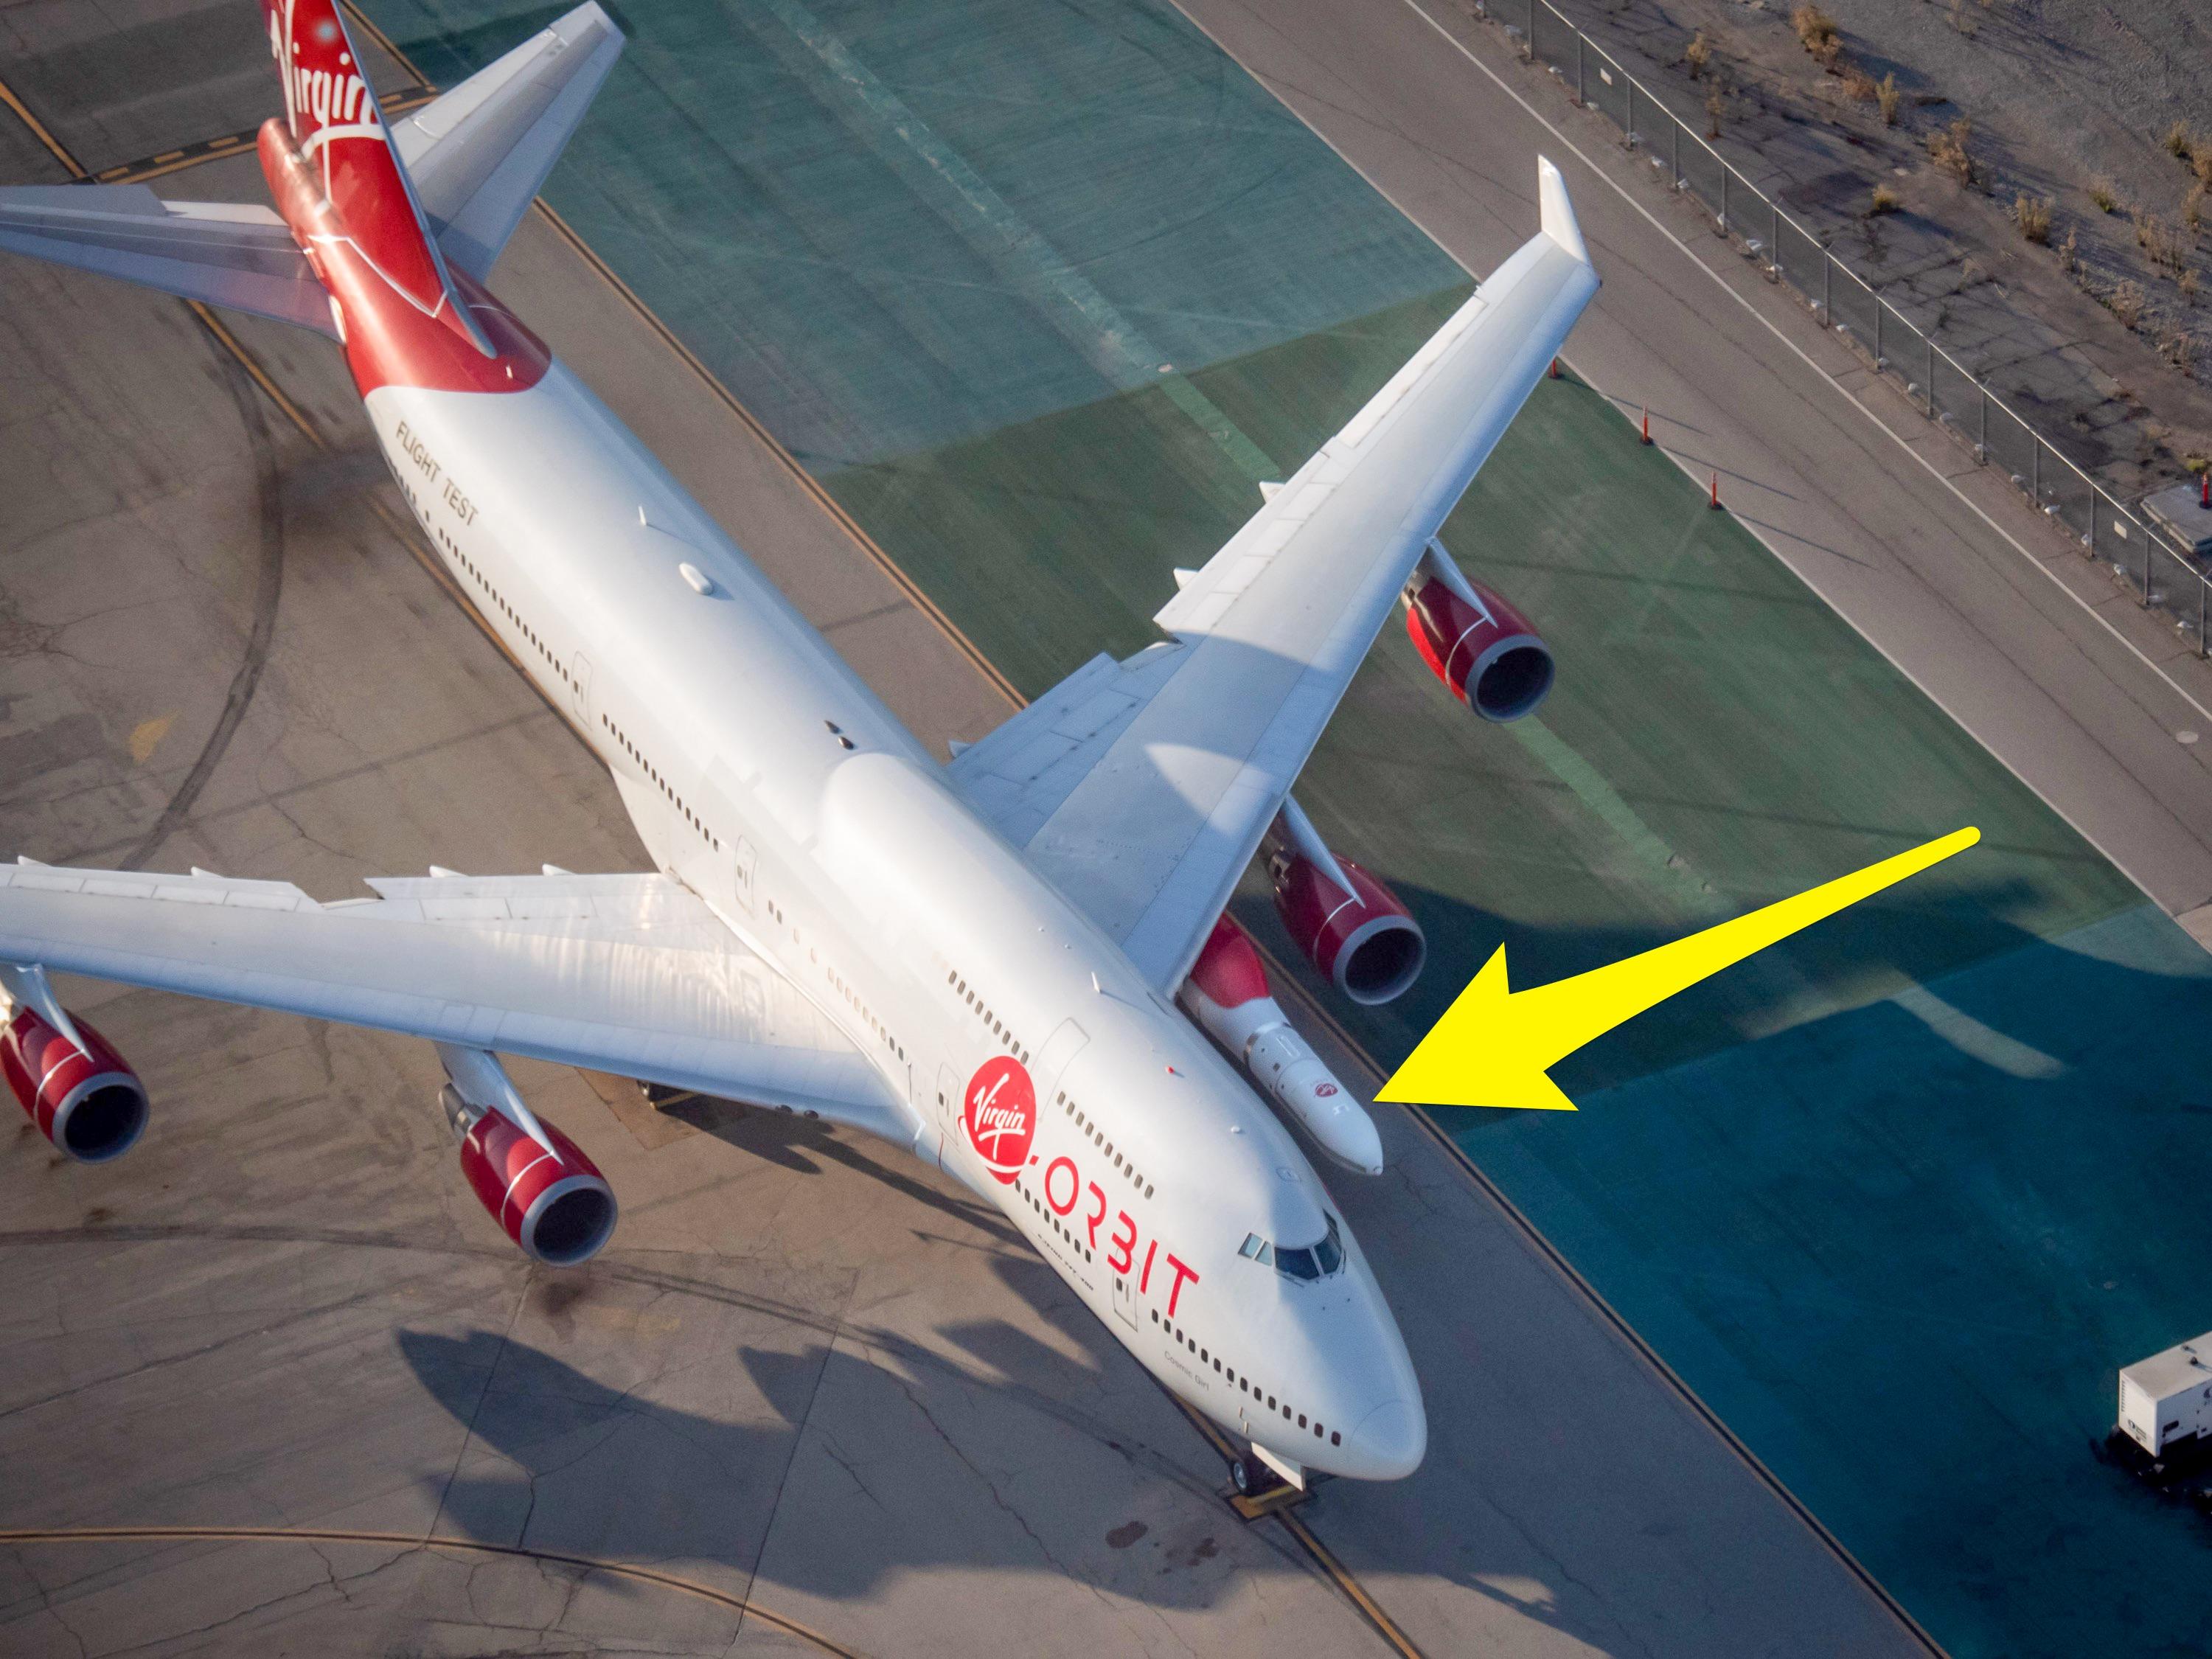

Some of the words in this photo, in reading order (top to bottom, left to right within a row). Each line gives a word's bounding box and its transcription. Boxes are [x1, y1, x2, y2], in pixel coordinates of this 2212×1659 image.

[270, 0, 386, 201] Virgin
[395, 420, 442, 483] FLIGHT
[442, 477, 479, 526] TEST
[973, 1072, 1026, 1161] Virgin
[1044, 1155, 1200, 1319] ORBIT
[1194, 1374, 1209, 1391] Girl
